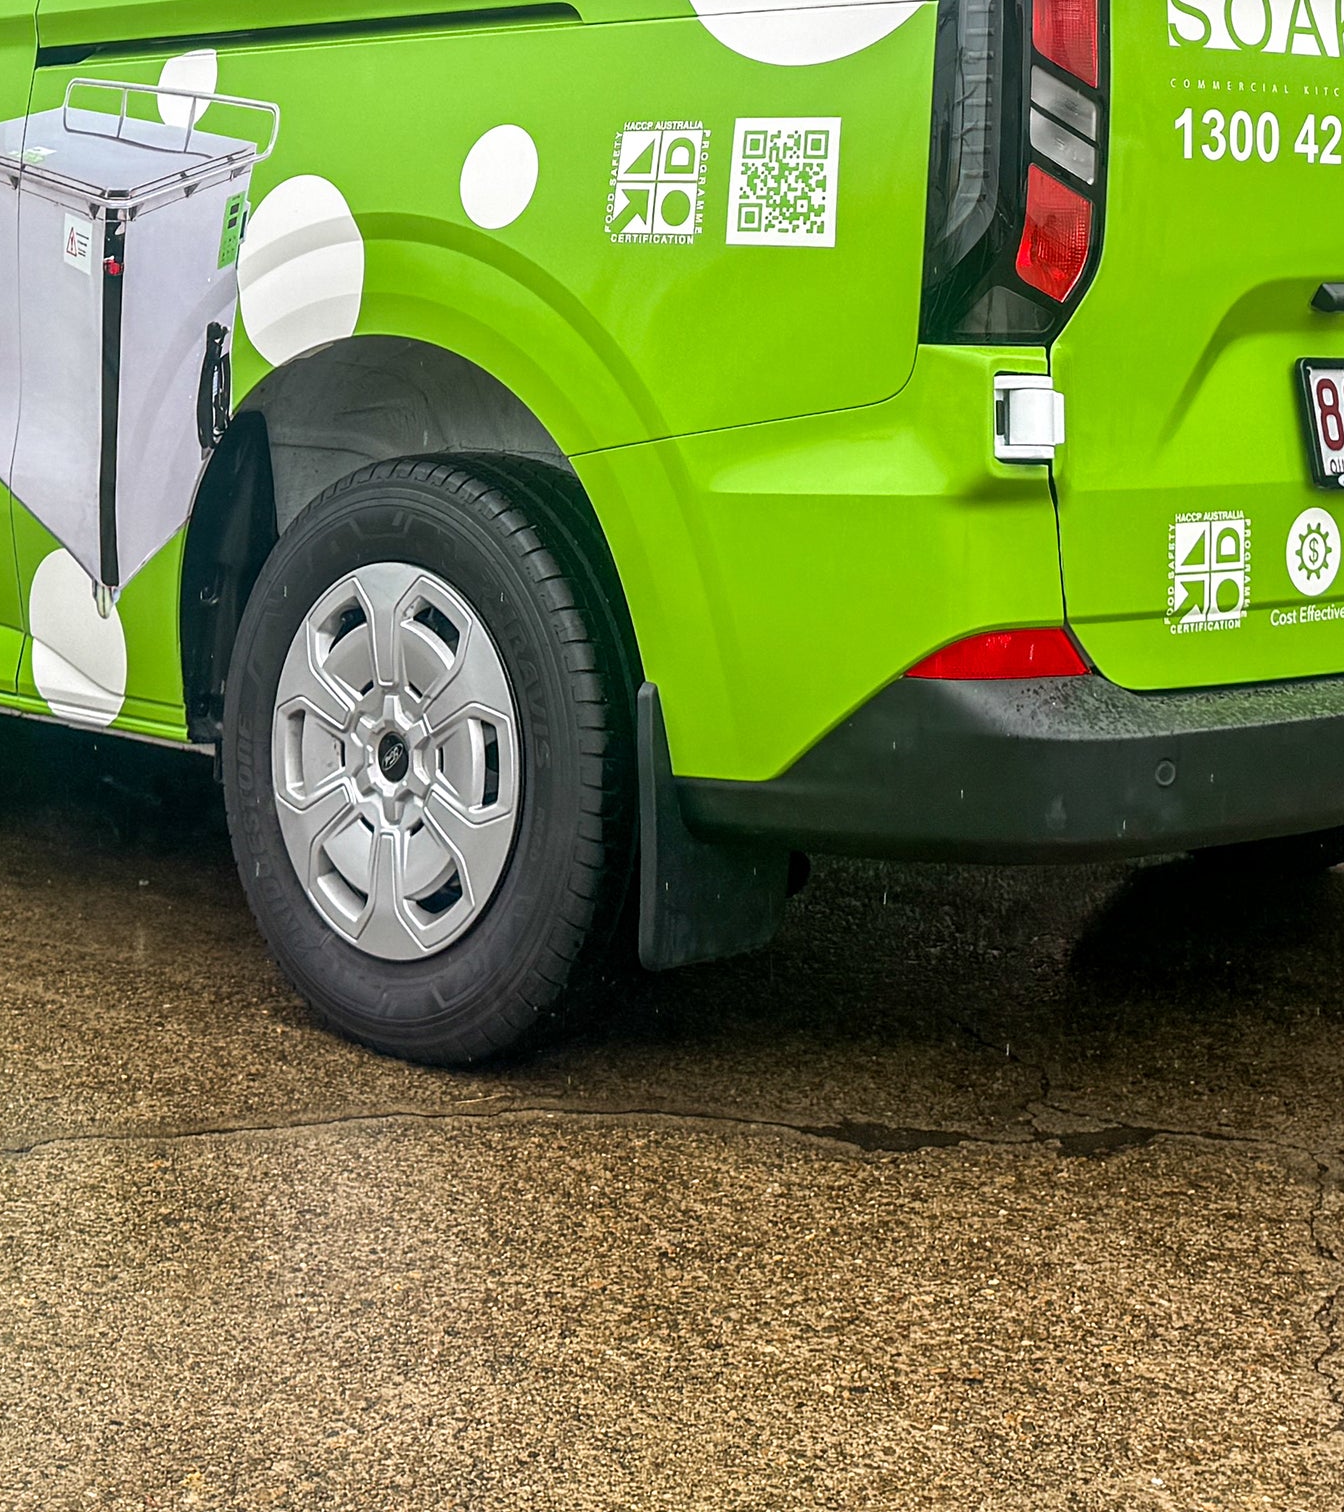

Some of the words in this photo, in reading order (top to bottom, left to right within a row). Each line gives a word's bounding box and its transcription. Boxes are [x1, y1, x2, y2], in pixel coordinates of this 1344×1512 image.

[1170, 77, 1290, 94] COMMERCIAL
[623, 121, 653, 132] HACCP
[654, 120, 704, 131] AUSTRALIA
[1174, 107, 1281, 163] 1300
[1294, 113, 1343, 165] 42
[610, 234, 694, 245] CERTIFICATION
[1175, 512, 1202, 523] HACCP
[1203, 510, 1245, 521] AUSTRALIA
[1270, 609, 1297, 626] Cost
[1170, 619, 1241, 634] CERTIFICATION
